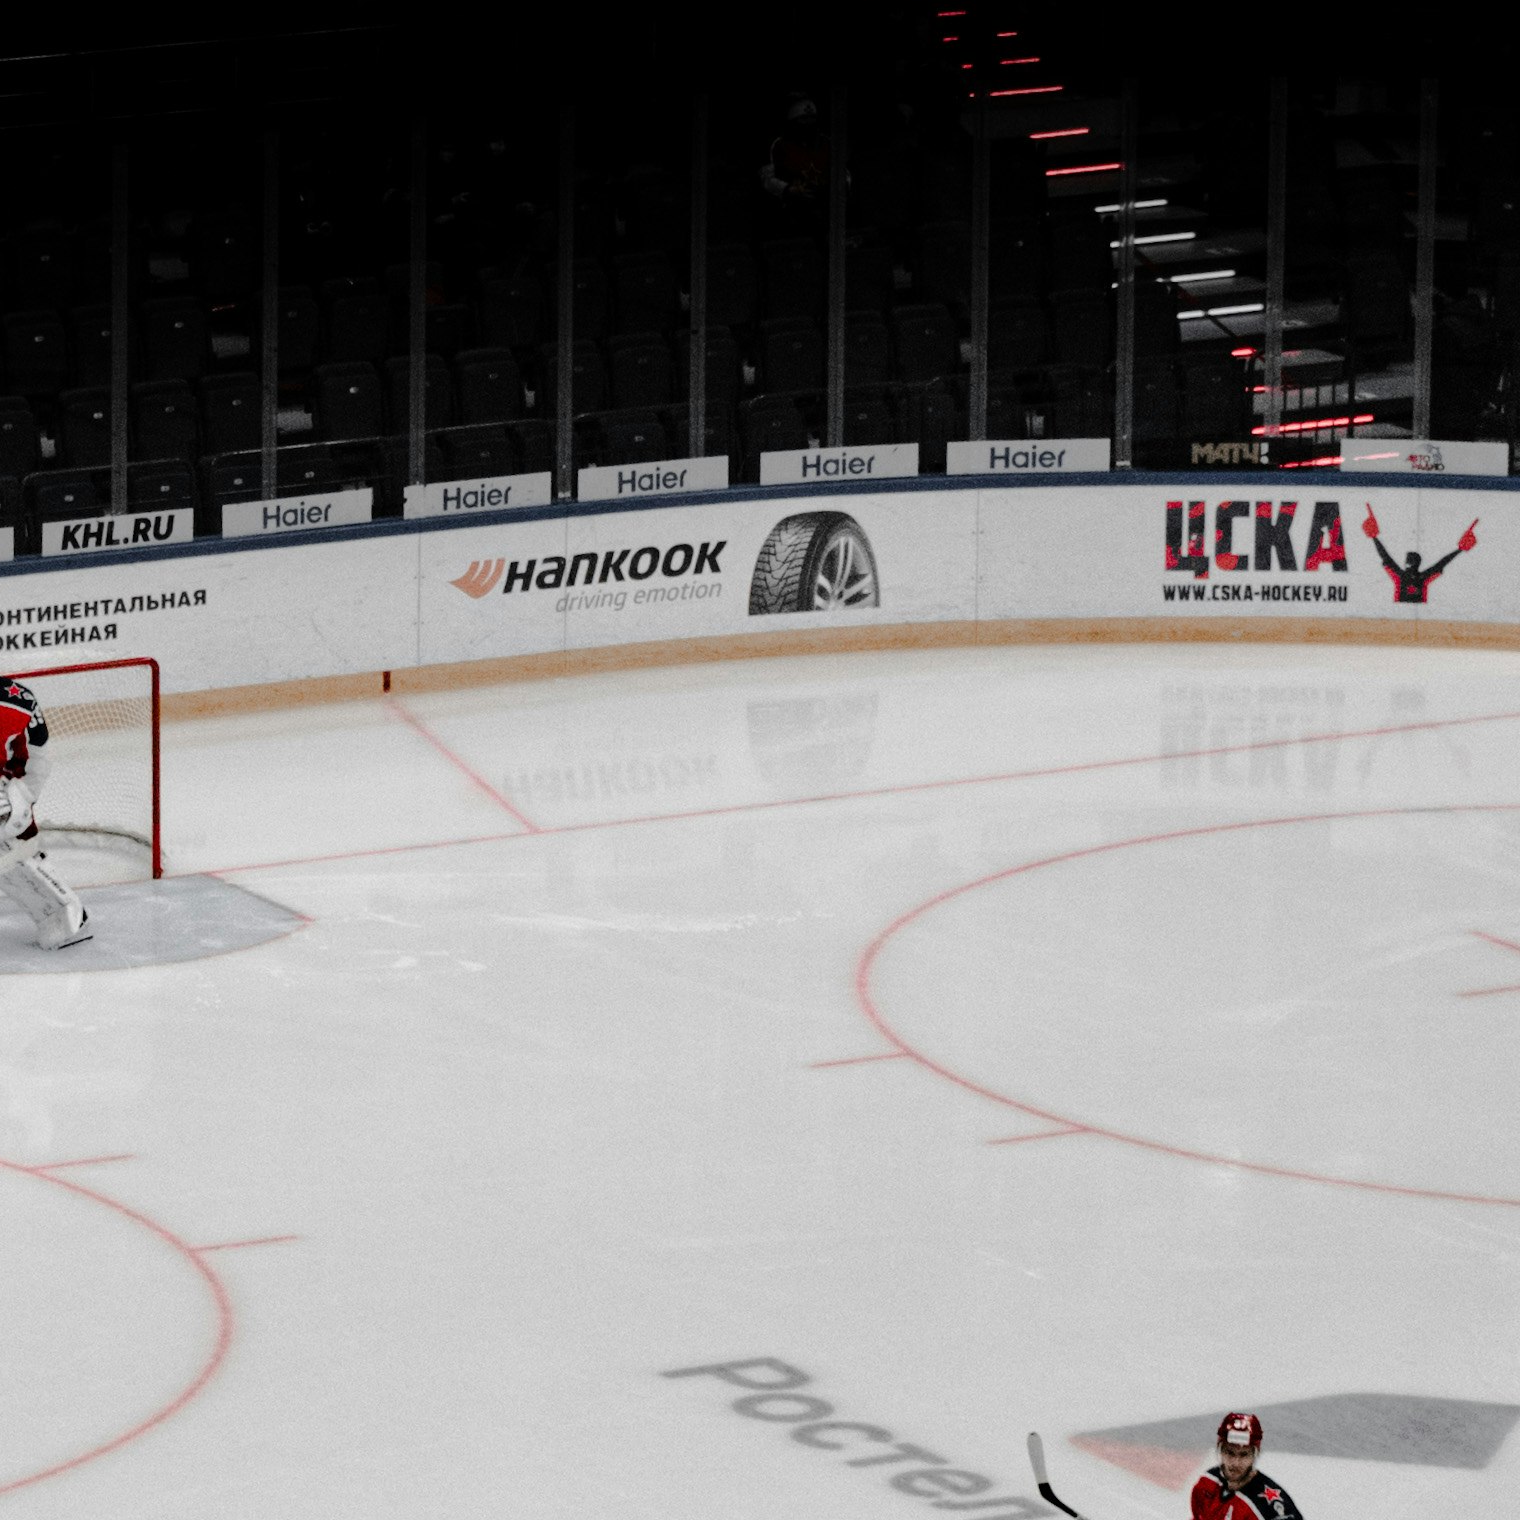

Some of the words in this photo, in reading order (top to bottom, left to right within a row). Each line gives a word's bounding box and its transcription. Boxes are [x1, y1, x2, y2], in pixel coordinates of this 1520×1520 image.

[801, 454, 875, 478] Haier
[988, 446, 1065, 469] Haier
[617, 468, 687, 495] Haier
[443, 483, 512, 511] Haier
[262, 501, 332, 529] Haier
[61, 515, 175, 551] KHL.RU
[1165, 500, 1348, 579] ЦСКА
[555, 587, 628, 613] driving
[632, 581, 723, 605] emotion
[1163, 584, 1348, 602] WWW.CSKA-HOCKEY.RU
